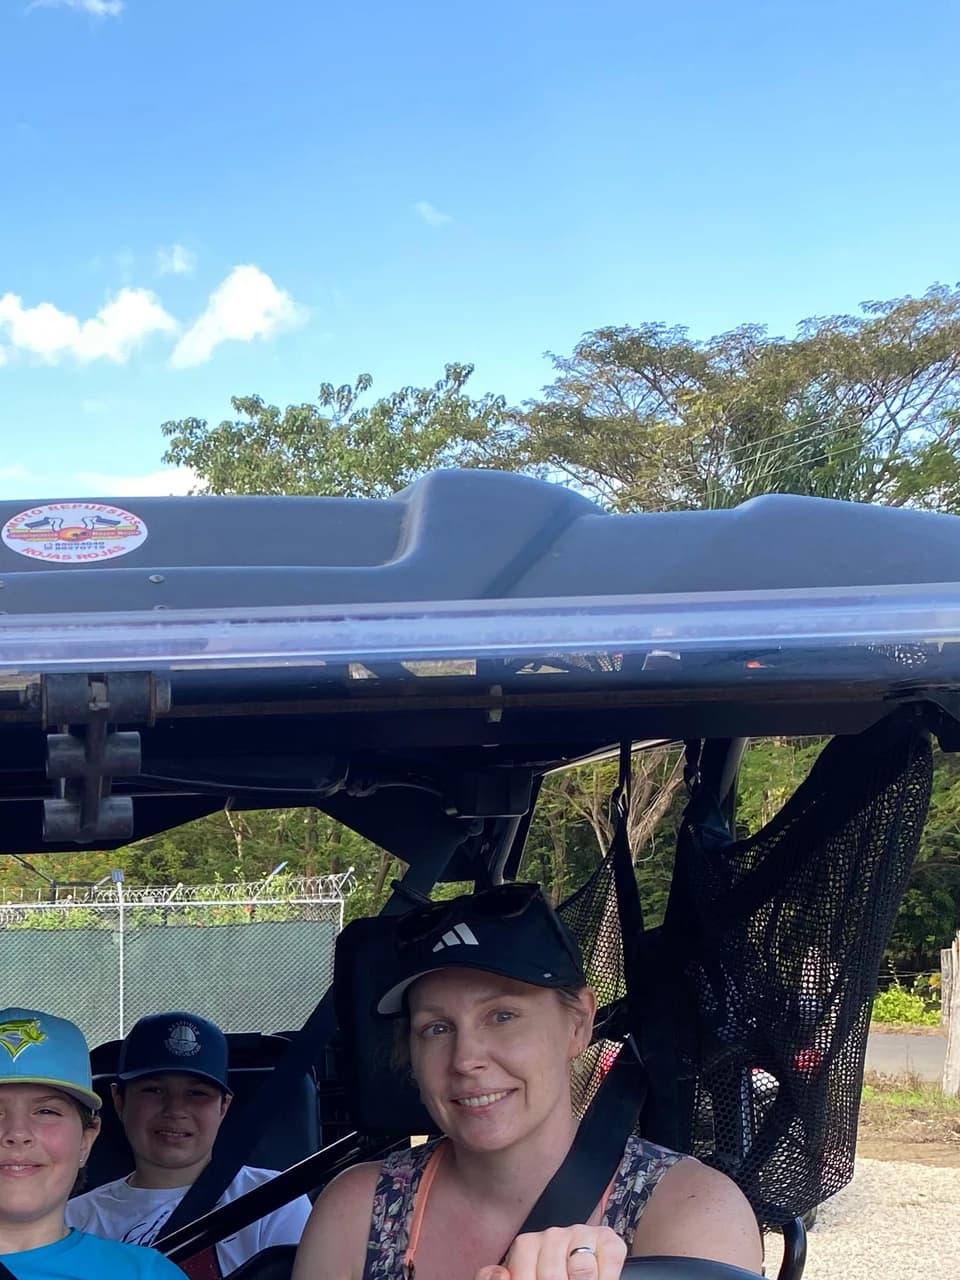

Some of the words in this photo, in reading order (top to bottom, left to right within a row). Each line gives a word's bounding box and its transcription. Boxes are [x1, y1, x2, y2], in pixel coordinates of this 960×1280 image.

[7, 509, 43, 528] MOTO
[48, 504, 141, 526] REPUESTOS
[22, 547, 72, 560] ROJAS
[76, 545, 126, 560] ROJAS
